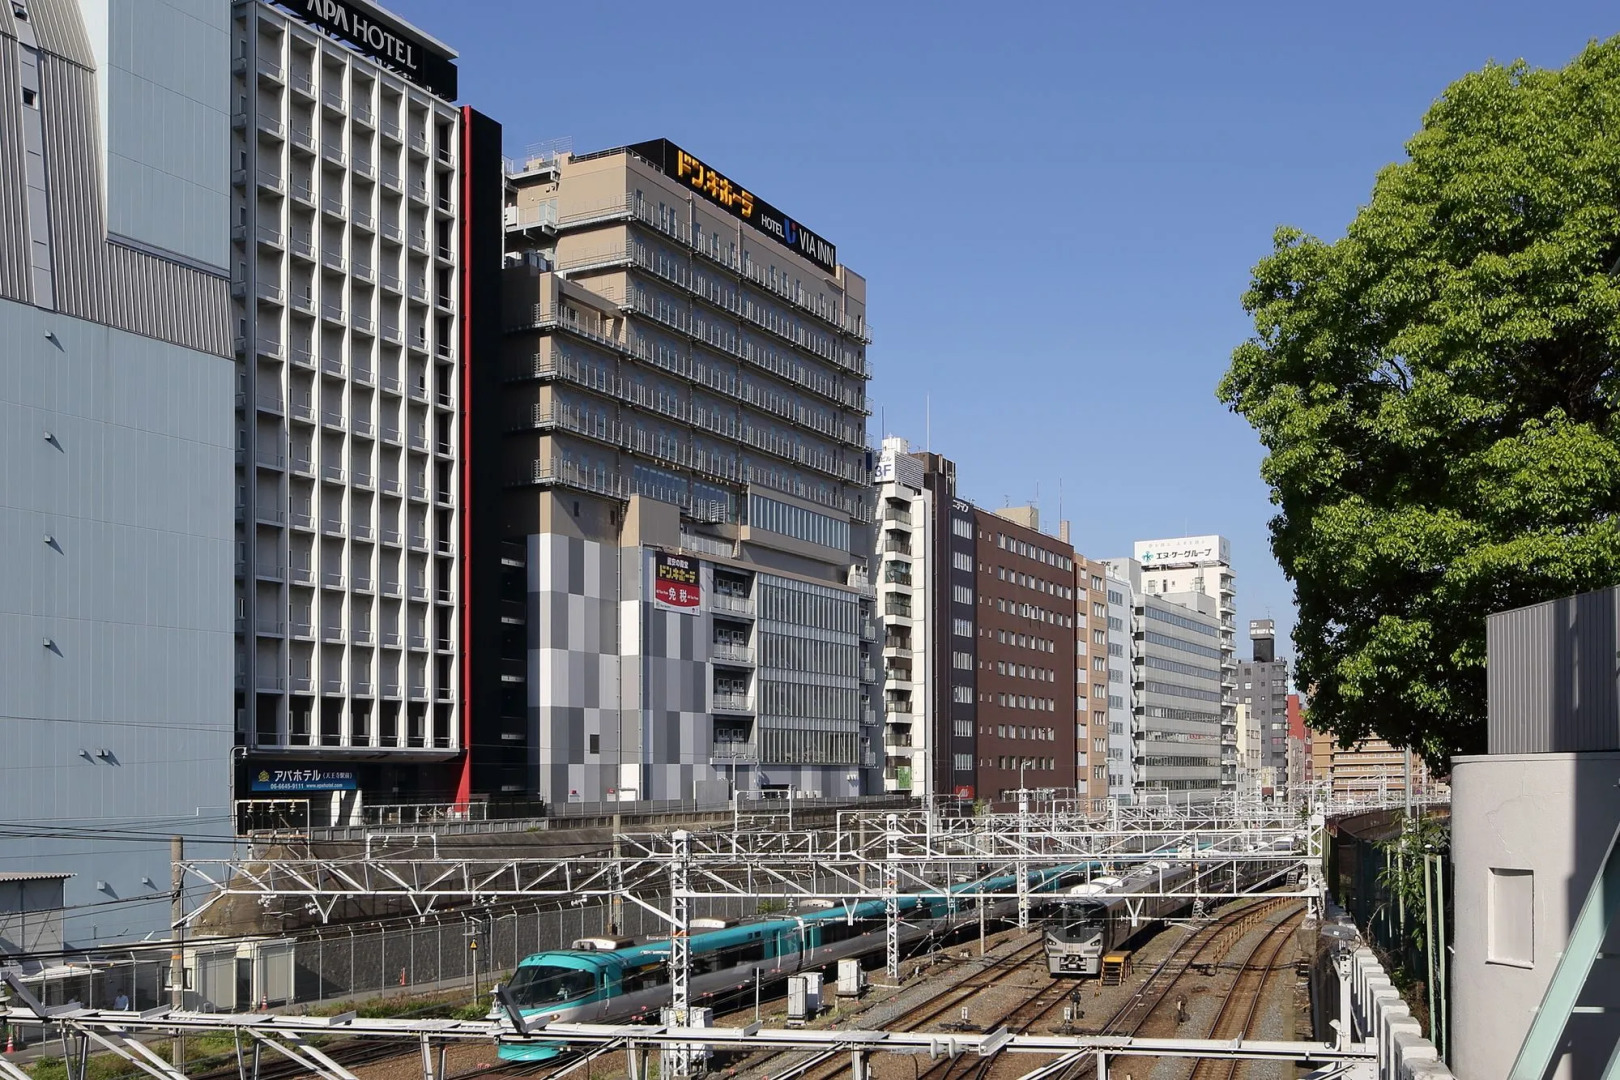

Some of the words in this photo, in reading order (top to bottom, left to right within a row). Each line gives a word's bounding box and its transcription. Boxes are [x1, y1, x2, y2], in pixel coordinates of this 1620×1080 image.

[306, 0, 349, 32] APA
[353, 13, 417, 70] HOTEL
[761, 213, 785, 238] HOTEL
[799, 228, 816, 257] VIA
[817, 239, 834, 268] INN
[274, 769, 321, 782] アパホテル
